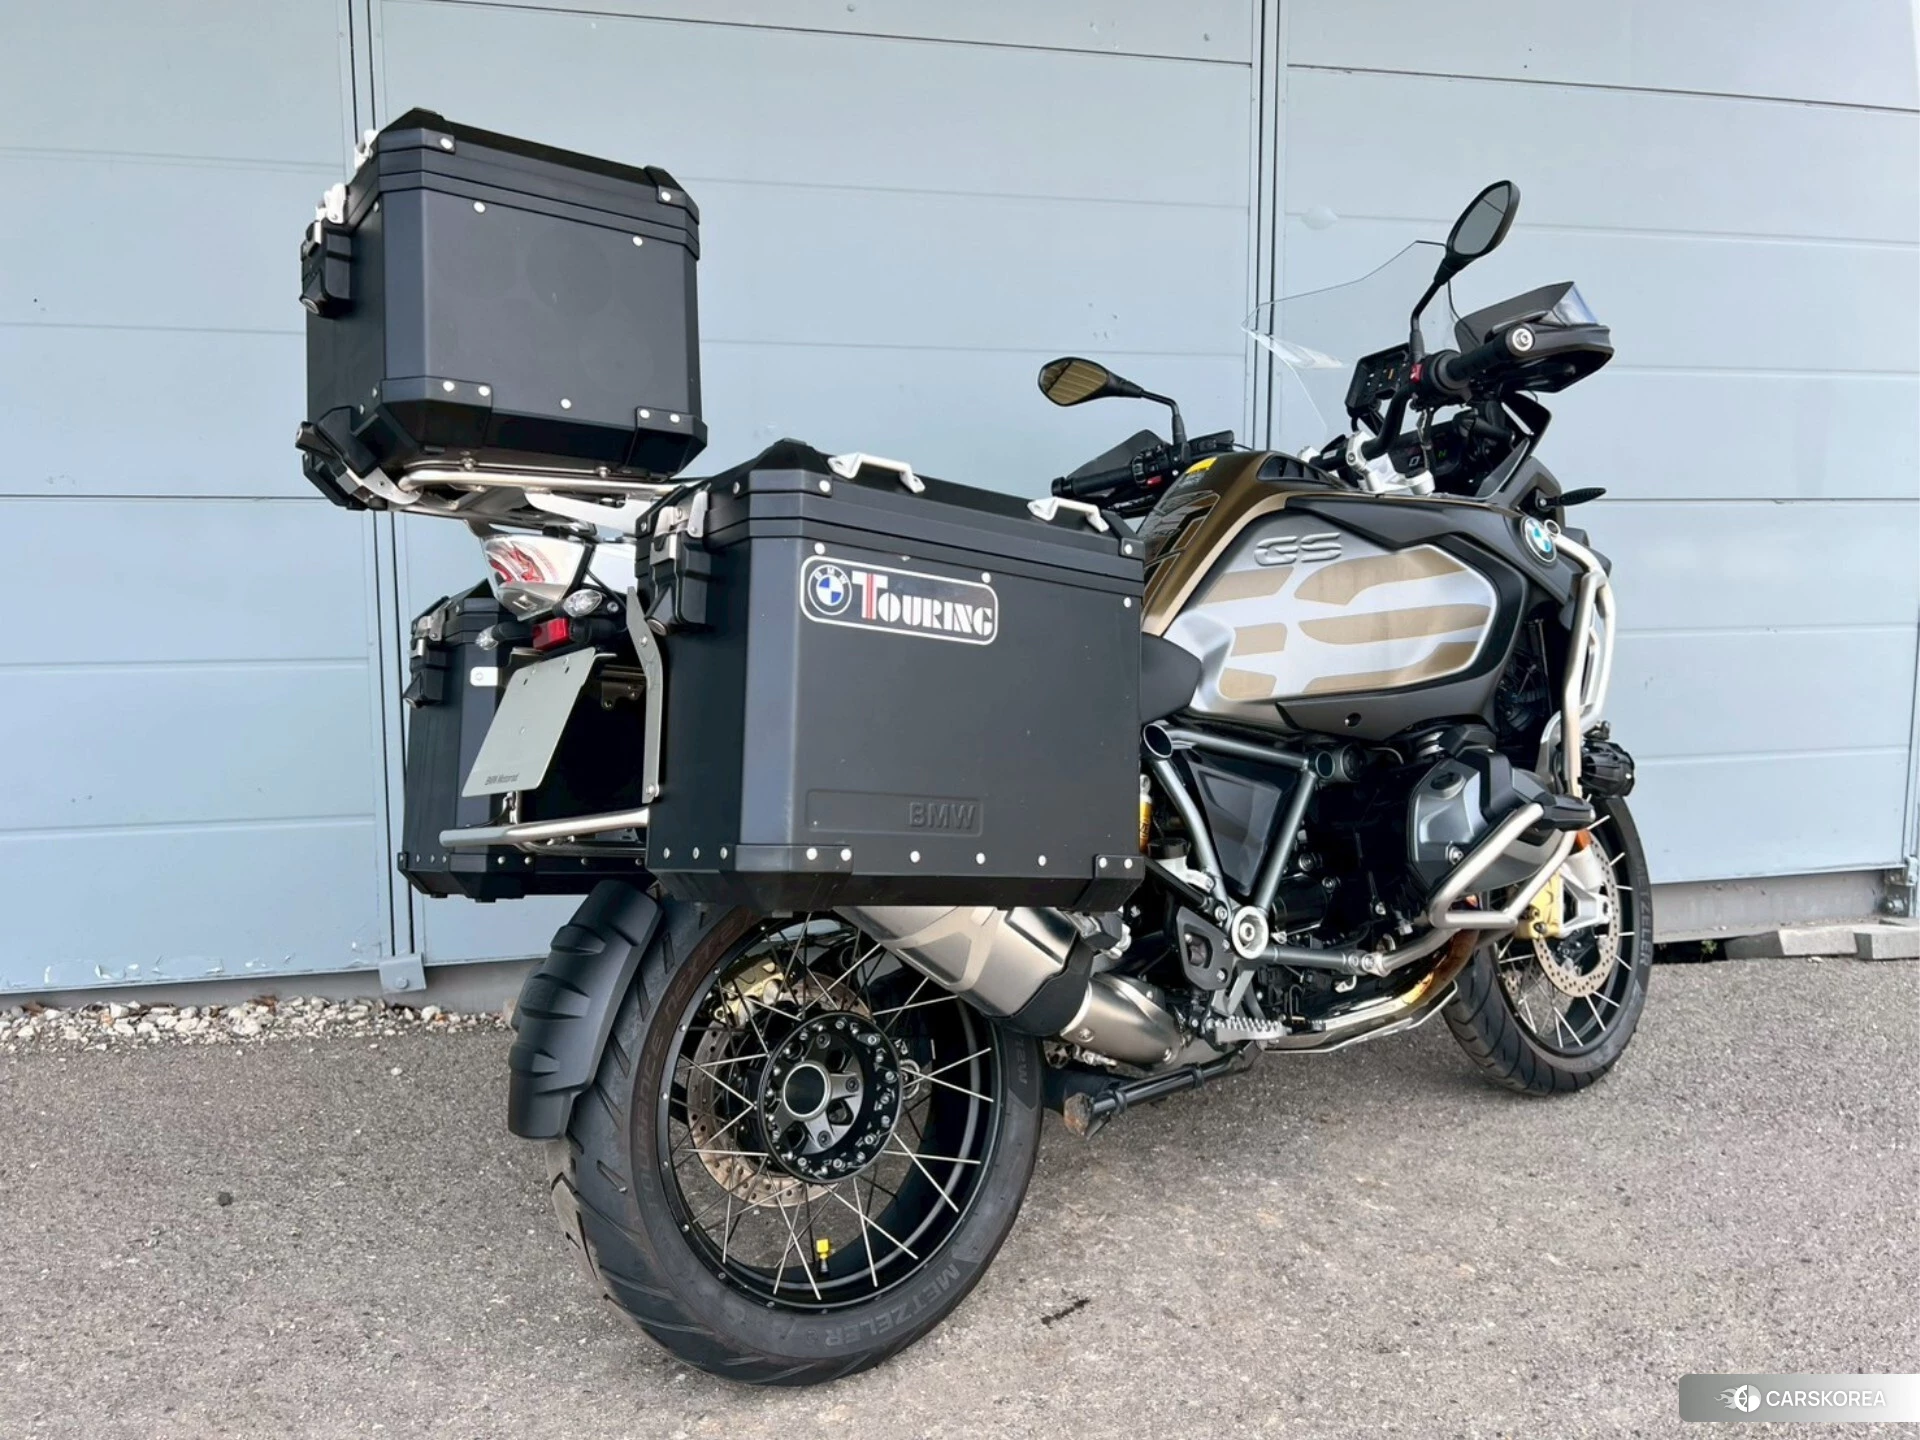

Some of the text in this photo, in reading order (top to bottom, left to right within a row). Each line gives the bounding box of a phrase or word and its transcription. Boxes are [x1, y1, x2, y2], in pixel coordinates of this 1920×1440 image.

[1254, 532, 1342, 567] GS
[813, 567, 848, 585] BMW
[909, 802, 976, 829] BMW
[1635, 865, 1650, 965] METZELER
[825, 1264, 961, 1346] METZELER
